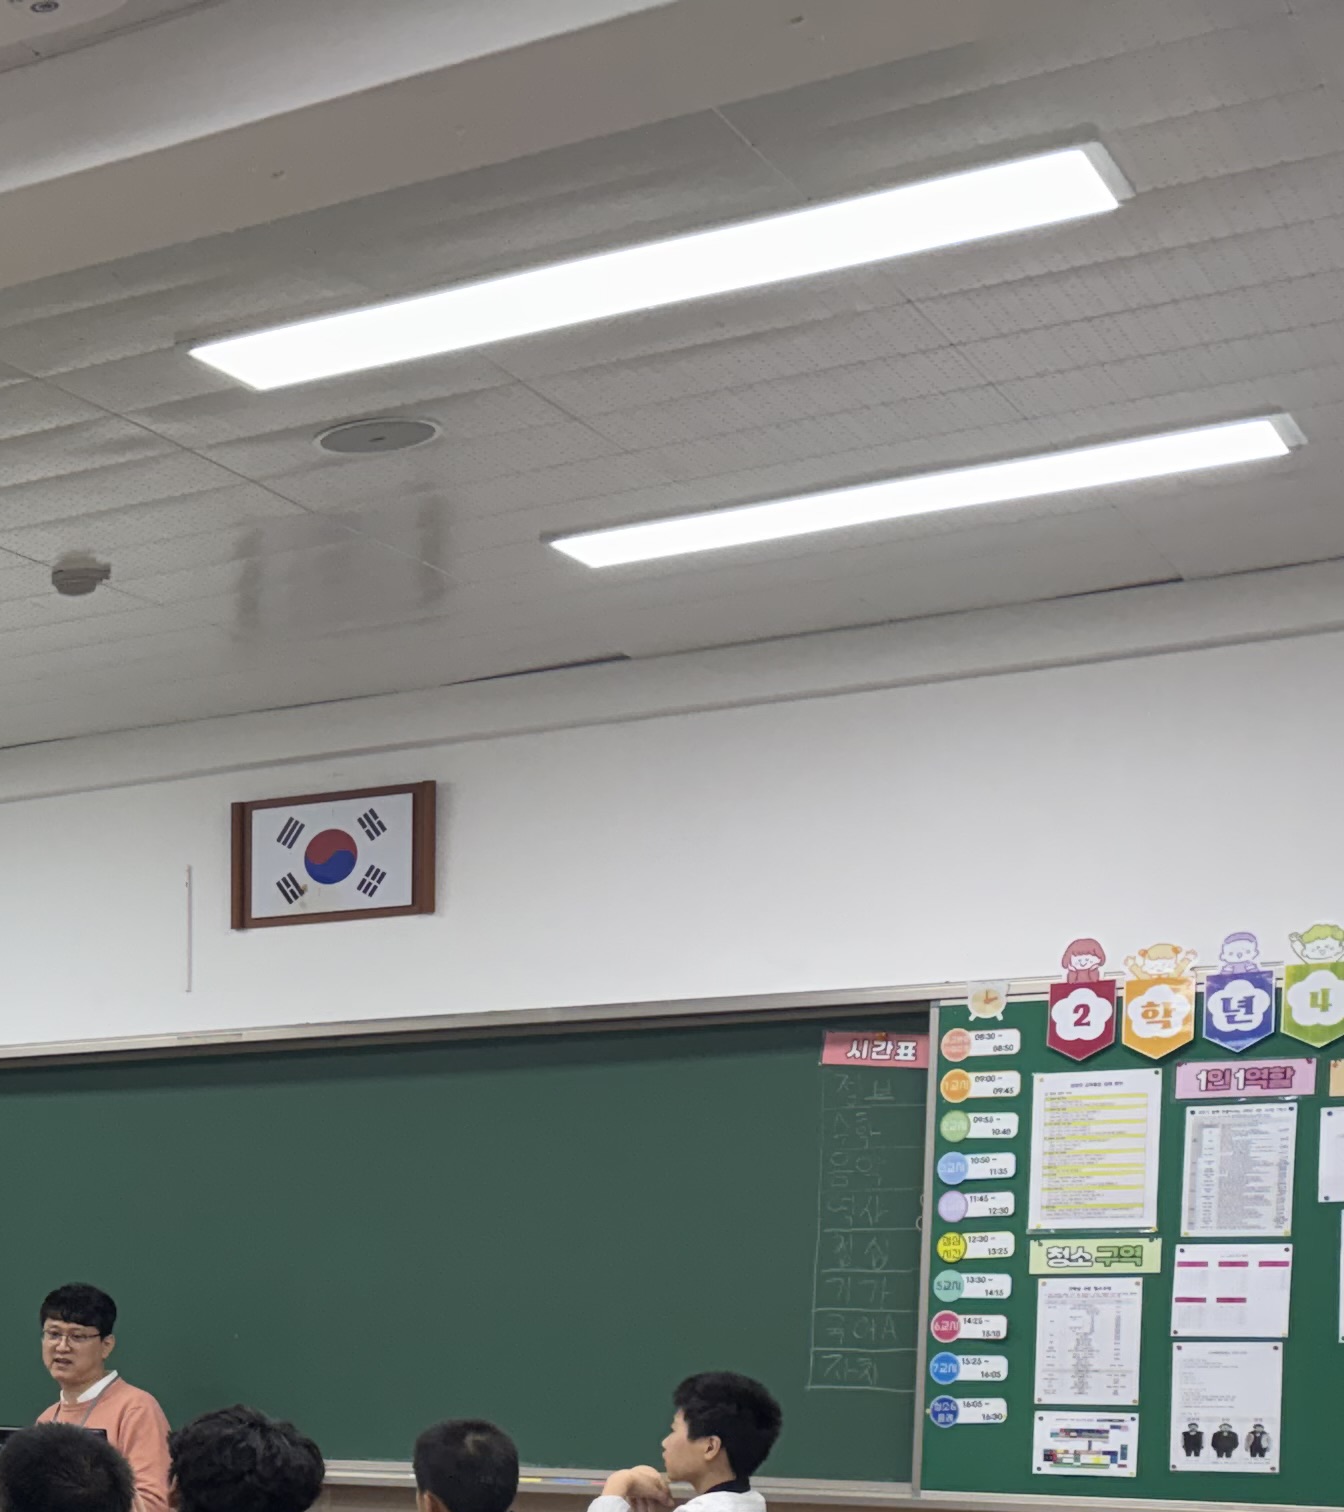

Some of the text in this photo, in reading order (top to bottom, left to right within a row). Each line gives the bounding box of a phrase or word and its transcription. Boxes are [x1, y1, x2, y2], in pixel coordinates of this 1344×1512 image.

[1073, 988, 1333, 1030] 2 학 년 4
[846, 1039, 917, 1061] 시간표
[1046, 1245, 1143, 1268] 청소 구역
